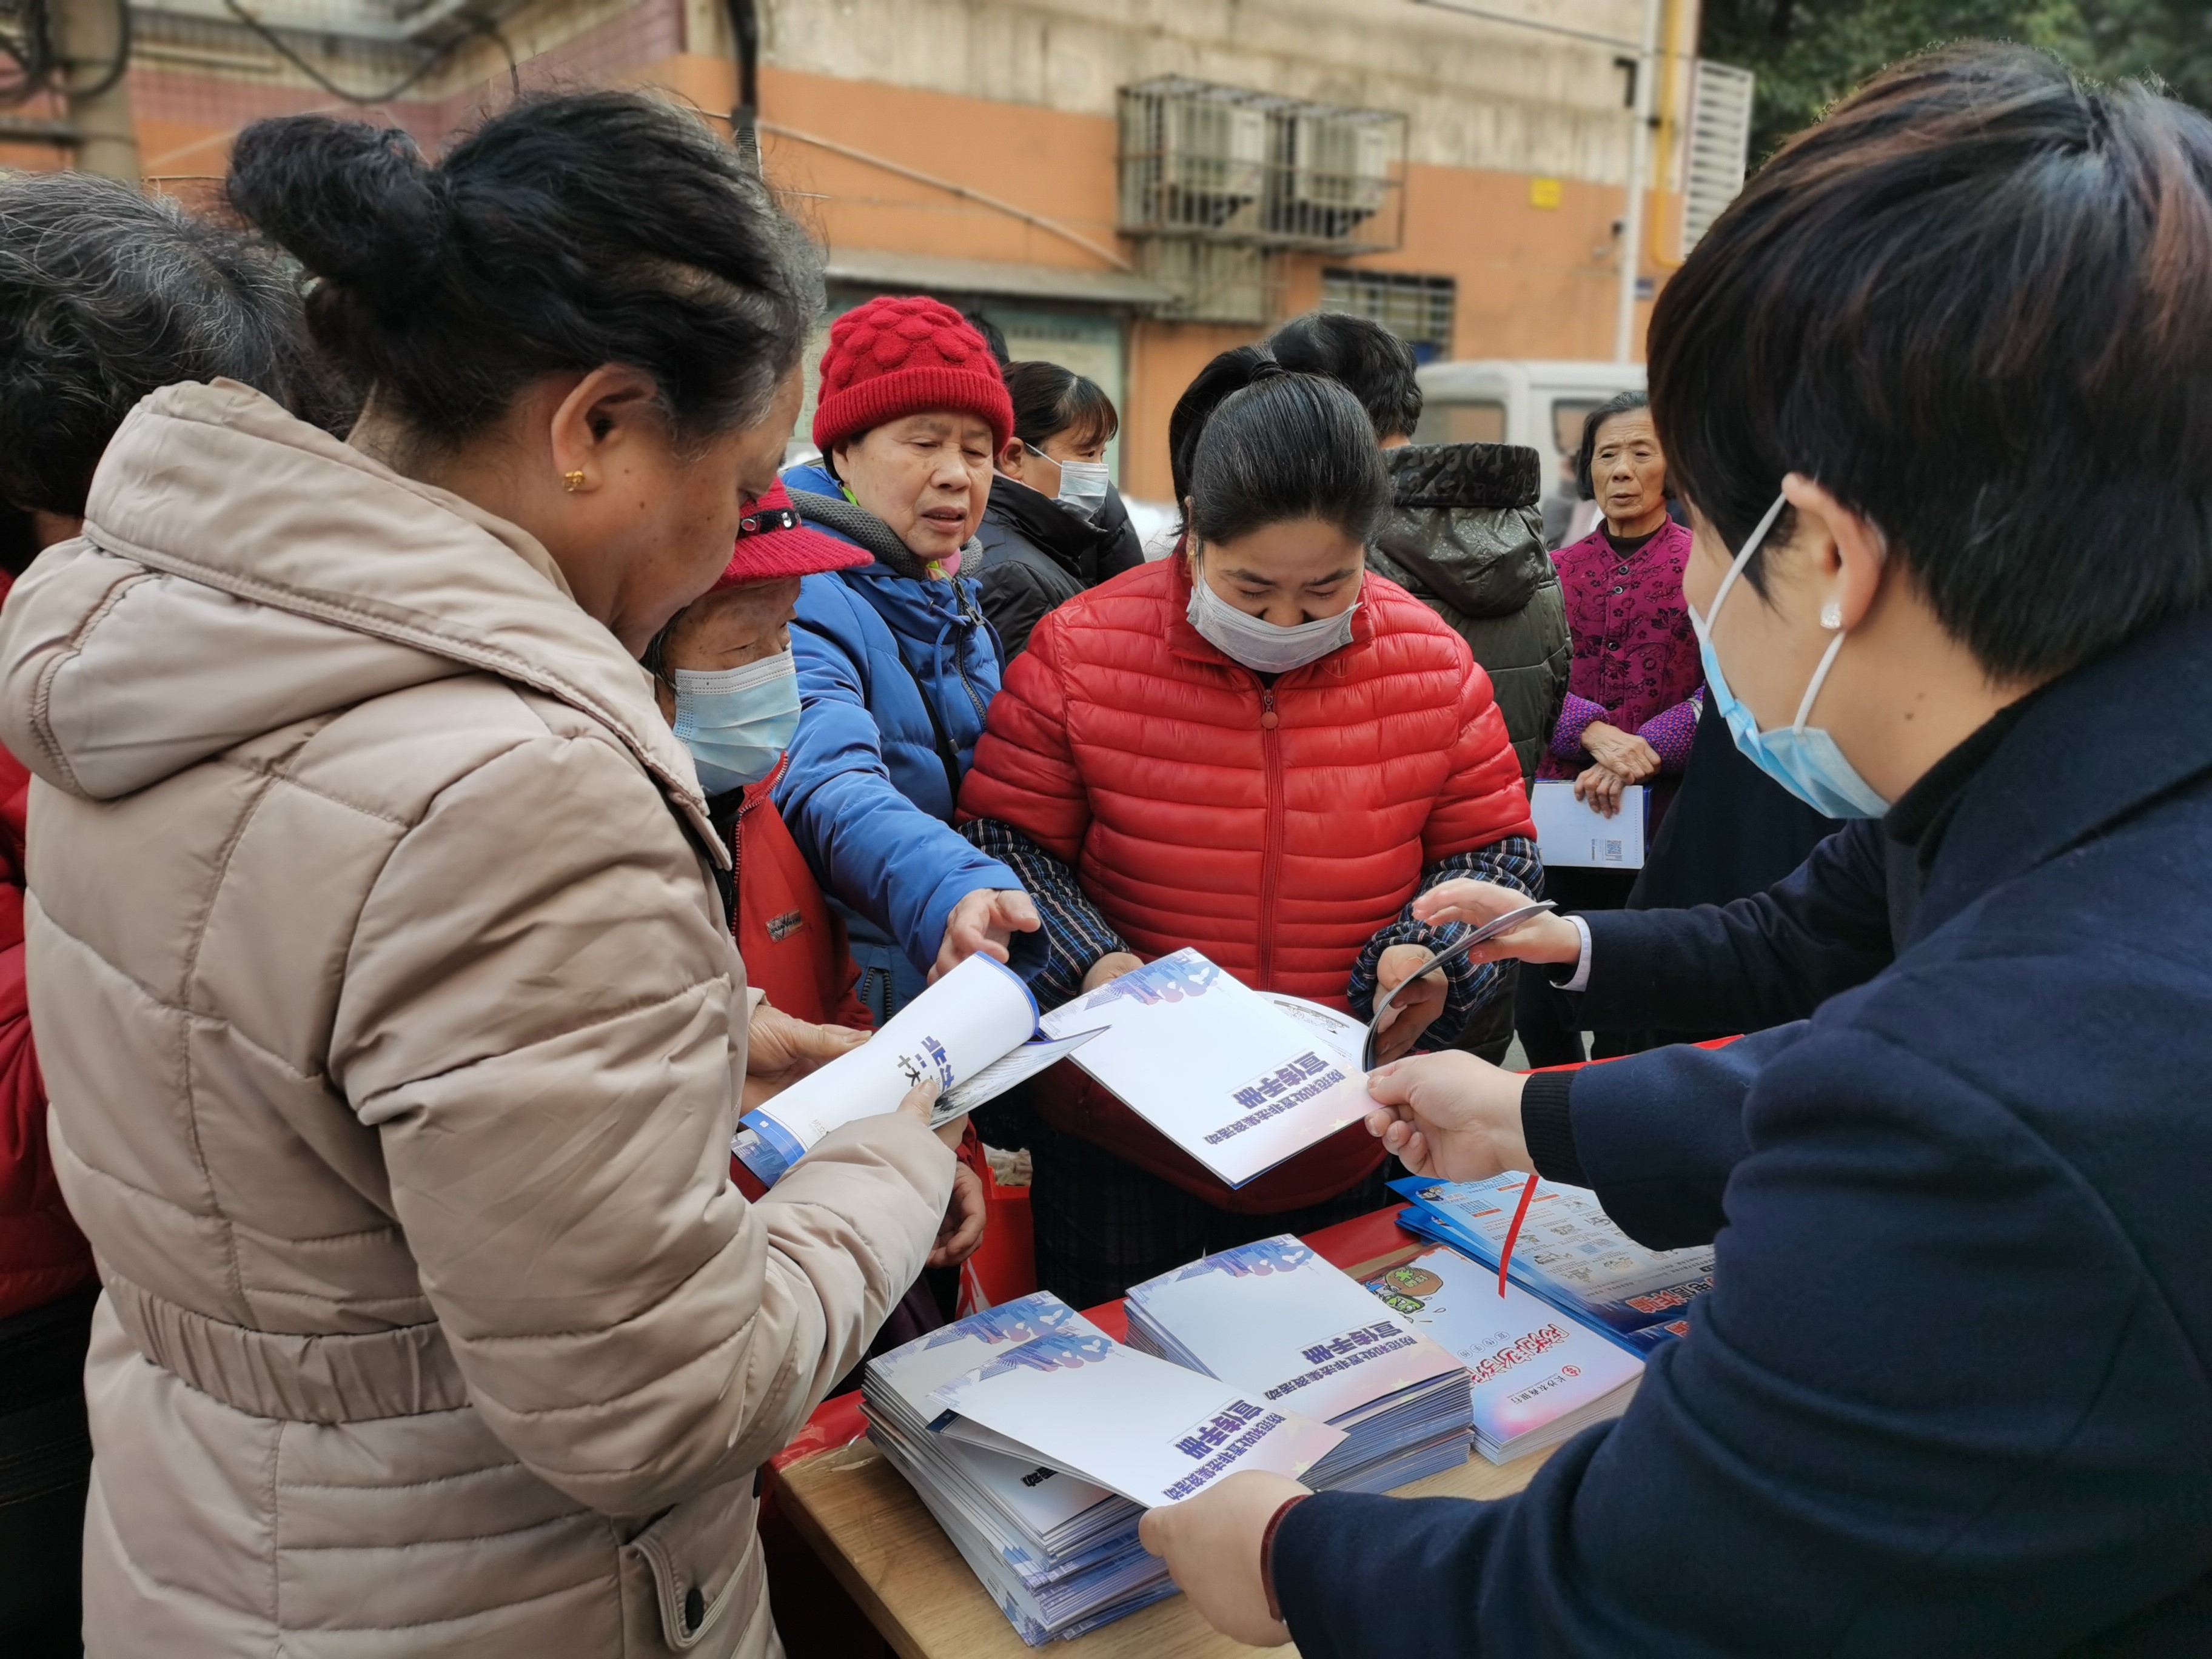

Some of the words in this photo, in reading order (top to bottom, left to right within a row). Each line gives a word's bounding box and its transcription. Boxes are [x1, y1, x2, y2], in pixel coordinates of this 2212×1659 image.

[1202, 1069, 1346, 1145] 防范和处置非法集资活动
[1232, 1051, 1330, 1110] 宣传手册
[1626, 1277, 1714, 1313] 电信诈骗
[1263, 1335, 1418, 1401] 防范和处置非法集资活动
[1301, 1320, 1404, 1365] 宣传手册
[1458, 1332, 1509, 1359] 宣传手册
[1465, 1324, 1570, 1386] 防范电信诈
[1510, 1375, 1566, 1404] 长沙农商银行
[1161, 1412, 1287, 1501] 防范和处置非法集资活动
[1173, 1399, 1265, 1460] 宣传手册
